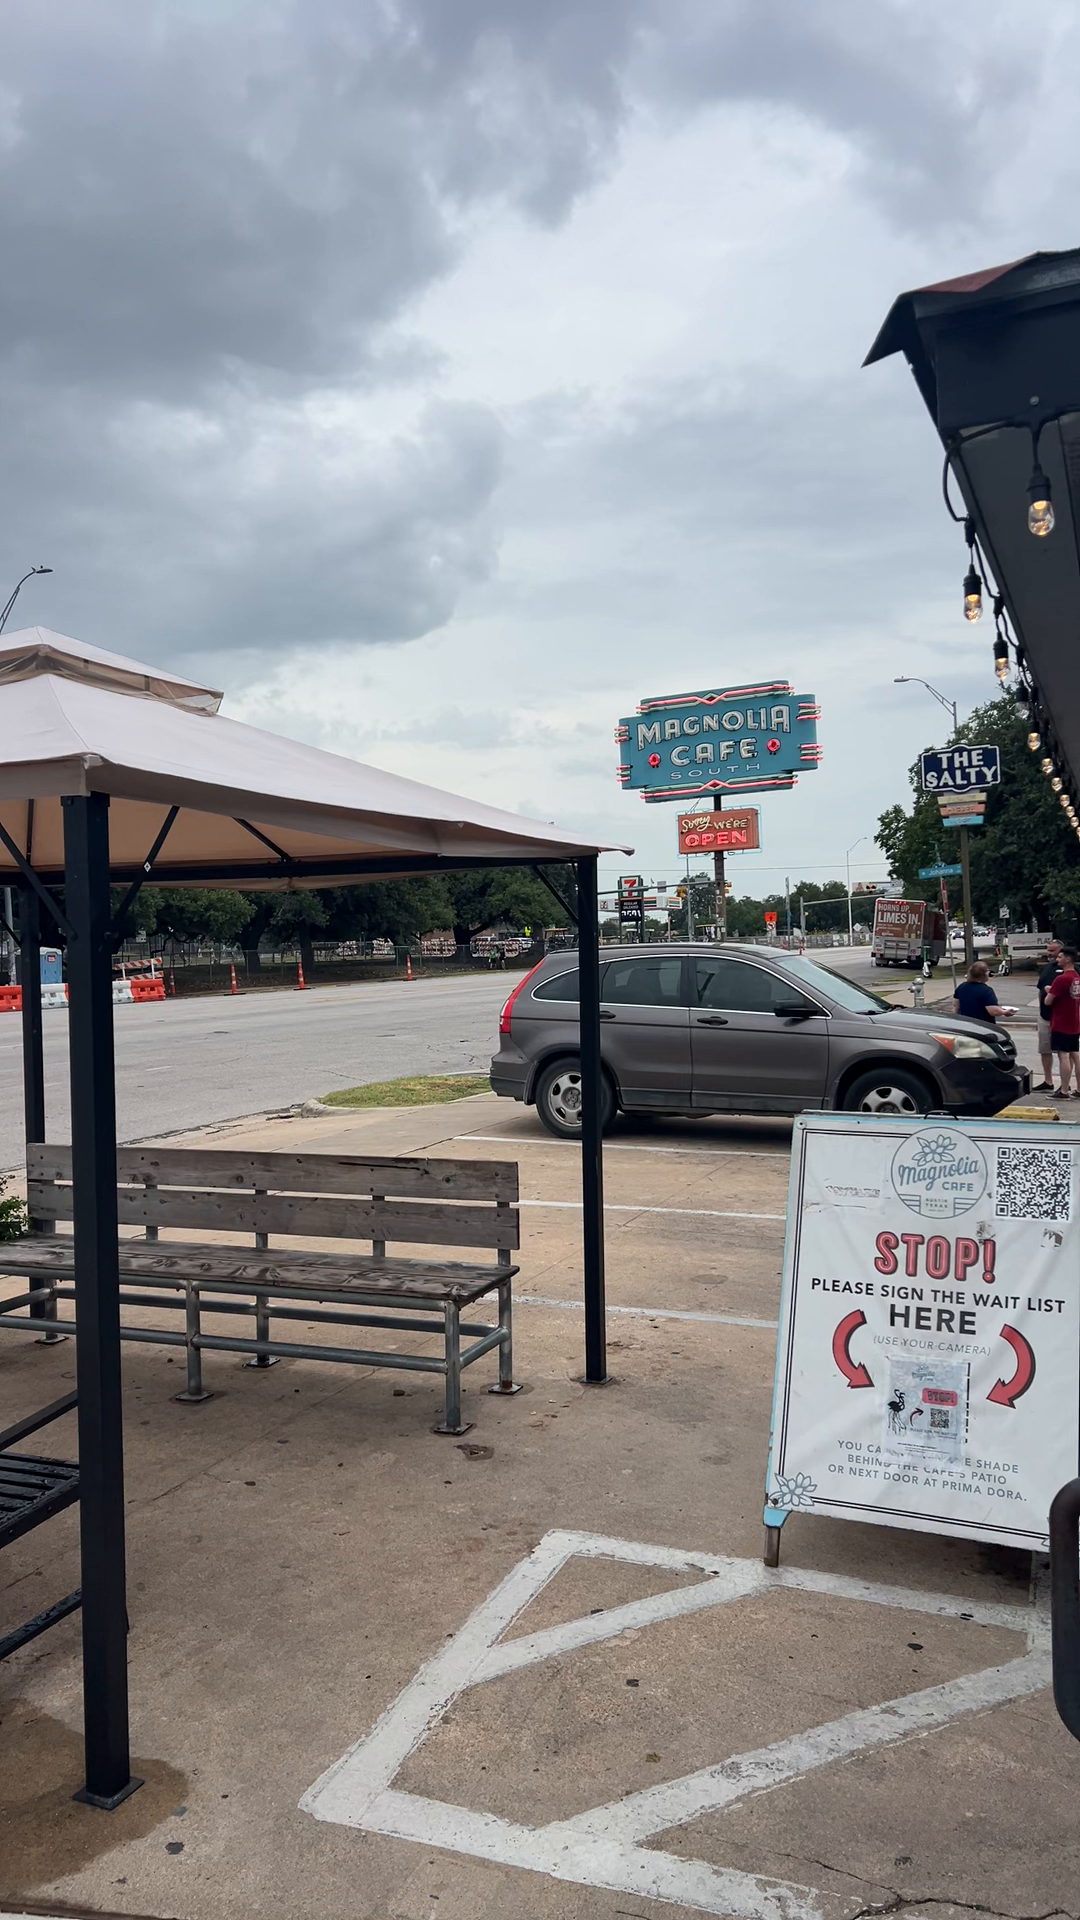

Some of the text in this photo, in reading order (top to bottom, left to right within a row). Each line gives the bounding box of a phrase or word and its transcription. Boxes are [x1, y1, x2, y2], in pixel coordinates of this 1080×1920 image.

[637, 704, 792, 751] MAGNOLIA
[670, 737, 757, 766] CAFE
[937, 749, 984, 769] THE
[670, 763, 761, 780] SOUTH
[925, 766, 997, 788] SALTY
[681, 815, 713, 833] Sorry
[685, 829, 747, 847] OPEN
[878, 903, 910, 913] HORNS UP.
[878, 912, 921, 925] LIMES IN.
[898, 1156, 979, 1191] Magnolia
[942, 1181, 974, 1192] CAFE
[873, 1230, 997, 1284] STOP!
[811, 1278, 1066, 1313] PLEASE SIGN THE WAIT LIST
[890, 1303, 976, 1336] HERE
[873, 1335, 991, 1356] (USE YOUR CAMERA)
[837, 1440, 863, 1452] YOU
[867, 1443, 882, 1454] CA
[976, 1459, 1019, 1474] SHADE
[828, 1464, 1027, 1502] OR NEXT DOOR AT PRIMA DORA.
[971, 1472, 1007, 1485] PATIO
